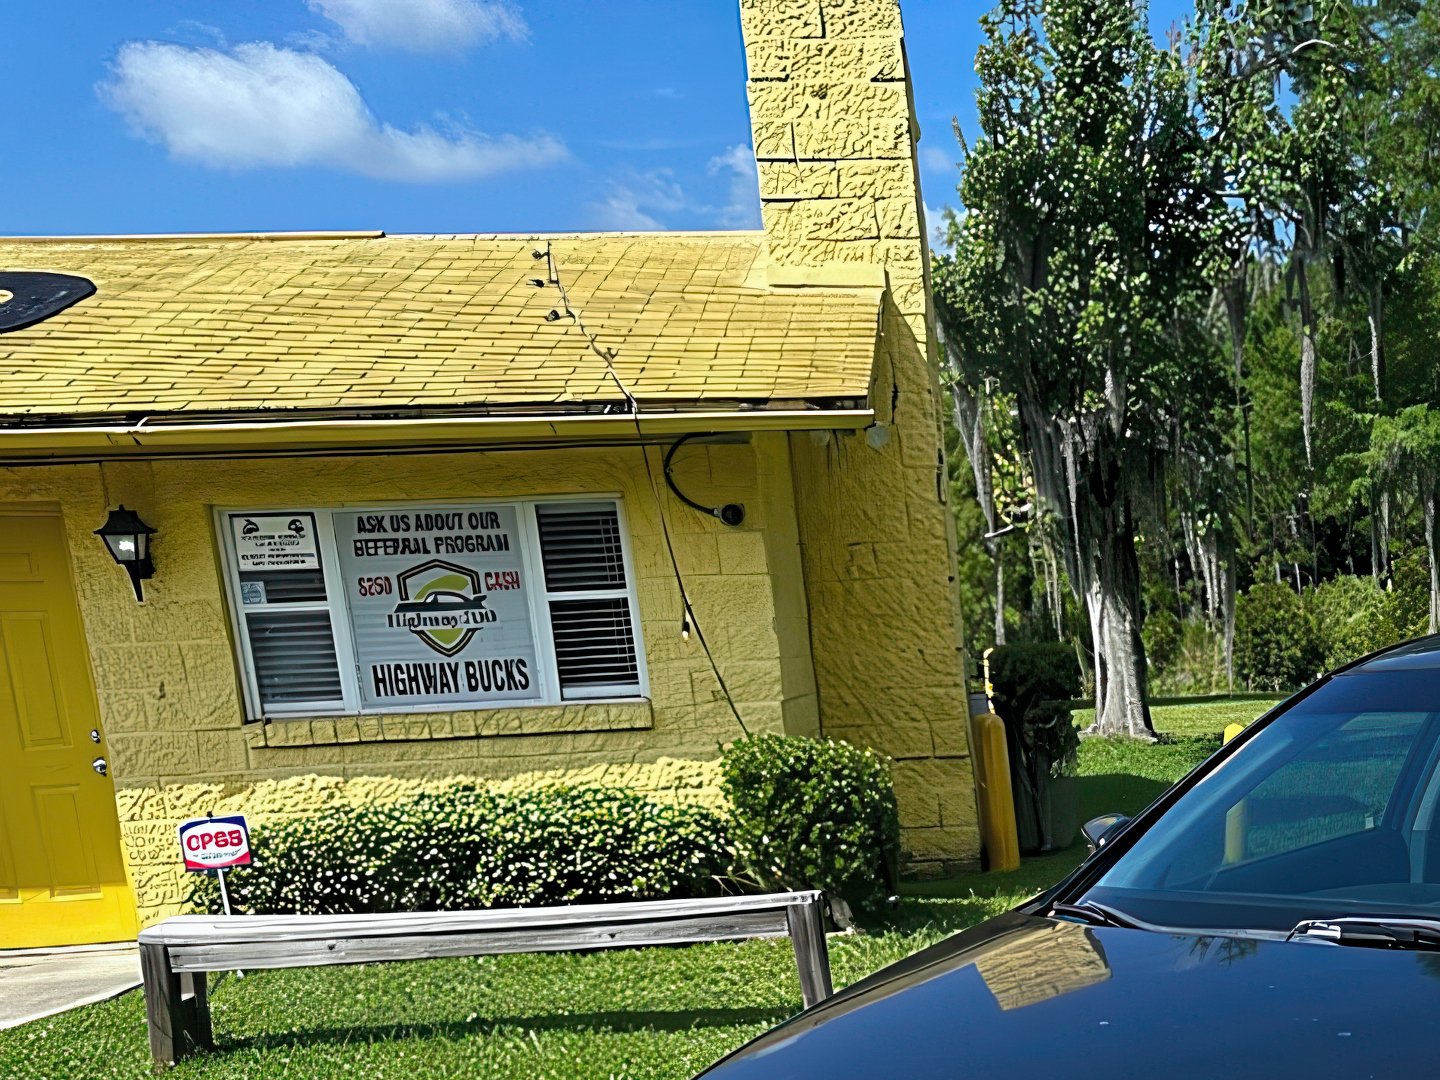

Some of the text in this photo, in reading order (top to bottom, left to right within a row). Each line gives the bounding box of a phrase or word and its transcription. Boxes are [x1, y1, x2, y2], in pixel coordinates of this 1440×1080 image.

[357, 515, 387, 534] ASK
[390, 514, 411, 533] US
[468, 511, 501, 530] OUR
[433, 533, 510, 554] PROGRAM
[371, 658, 530, 698] HIGHWAY BUCKS
